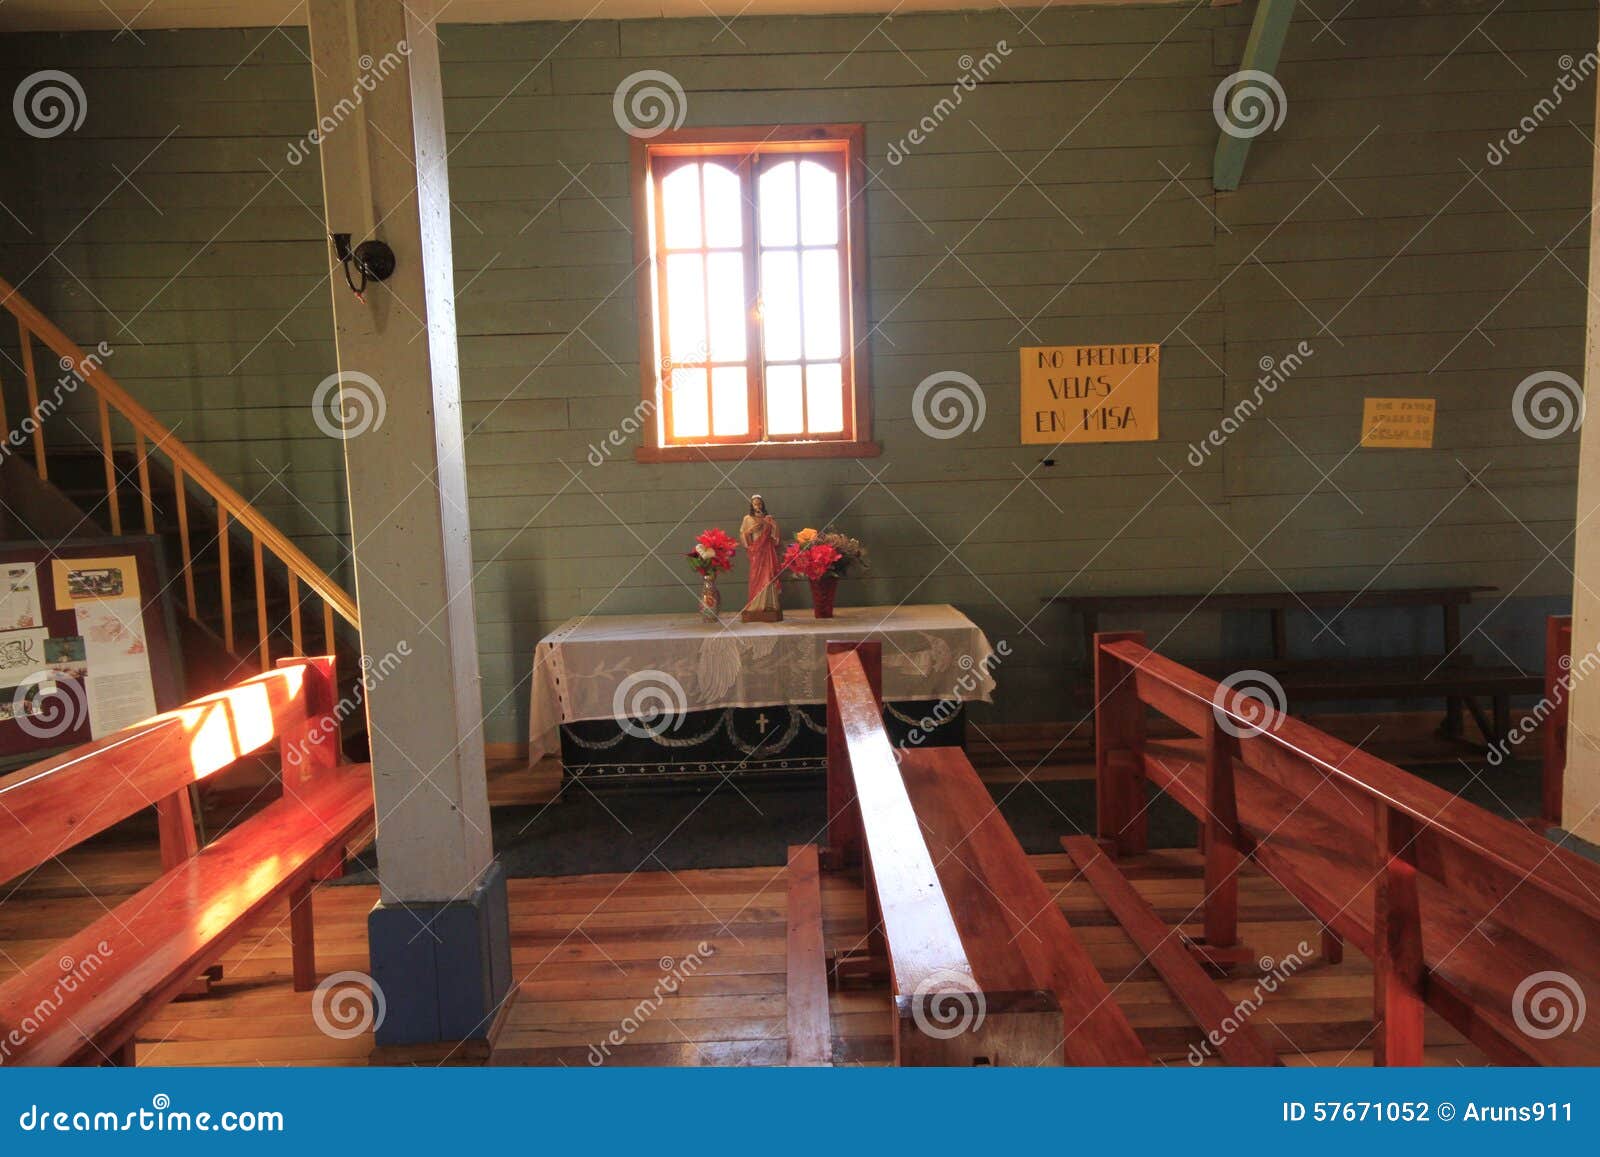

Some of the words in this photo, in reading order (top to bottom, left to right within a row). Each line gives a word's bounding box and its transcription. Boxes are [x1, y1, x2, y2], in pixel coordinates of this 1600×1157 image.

[1038, 350, 1064, 368] NO
[1076, 346, 1157, 366] PRENDER
[1048, 376, 1111, 400] VELAS
[1036, 408, 1066, 432] EN
[1083, 405, 1138, 430] MISA
